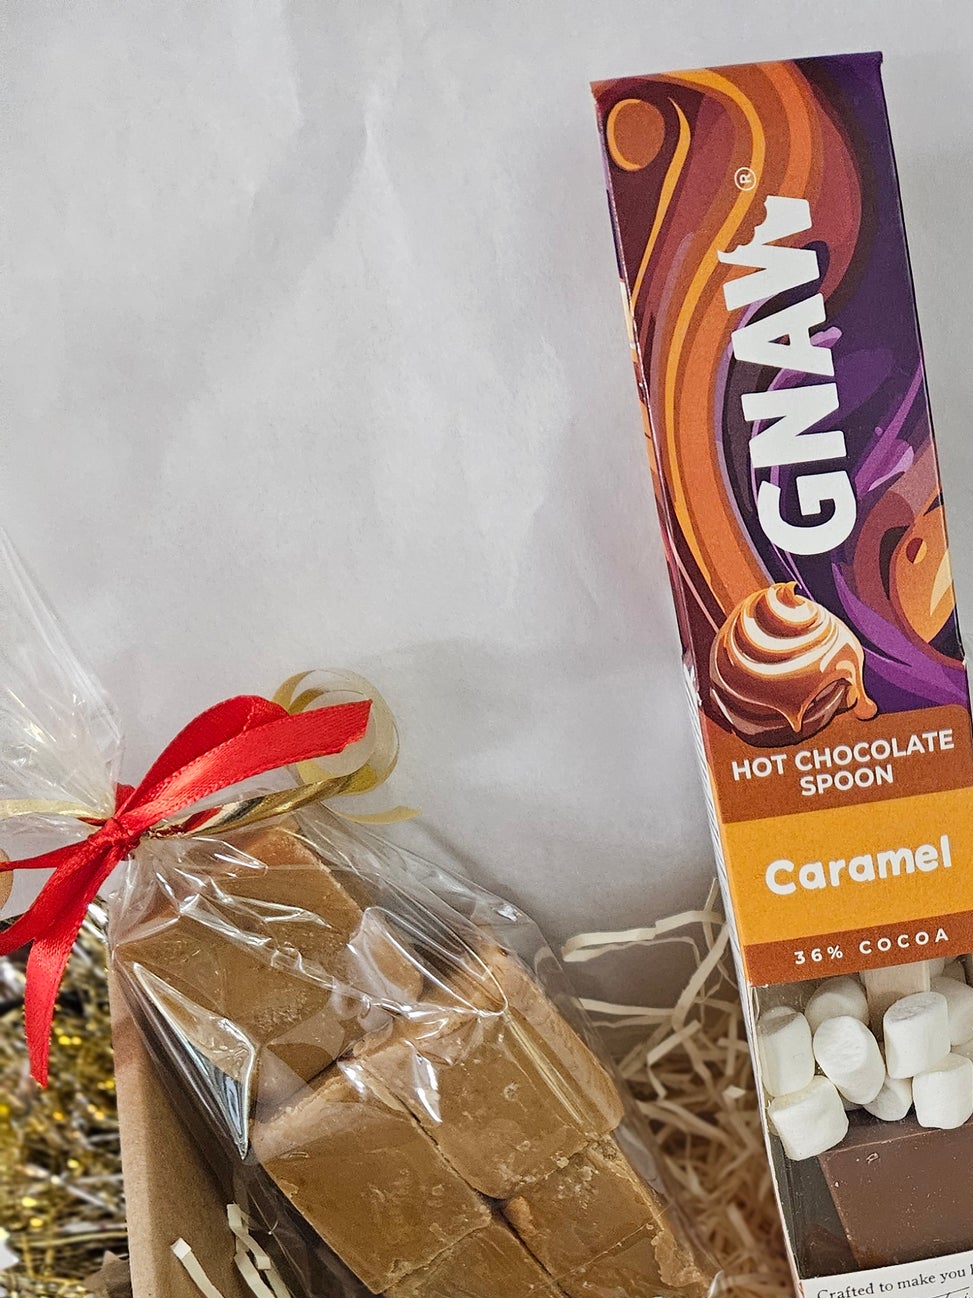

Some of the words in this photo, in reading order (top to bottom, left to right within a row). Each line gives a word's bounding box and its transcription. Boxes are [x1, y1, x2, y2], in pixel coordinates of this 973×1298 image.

[717, 195, 857, 555] GNAW
[731, 753, 788, 781] HOT
[795, 728, 955, 771] CHOCOLATE
[799, 764, 894, 796] SPOON
[765, 834, 953, 895] Caramel
[794, 944, 844, 965] 36%
[859, 927, 949, 955] COCOA
[879, 1280, 894, 1293] to
[897, 1273, 936, 1290] make
[939, 1267, 967, 1285] you
